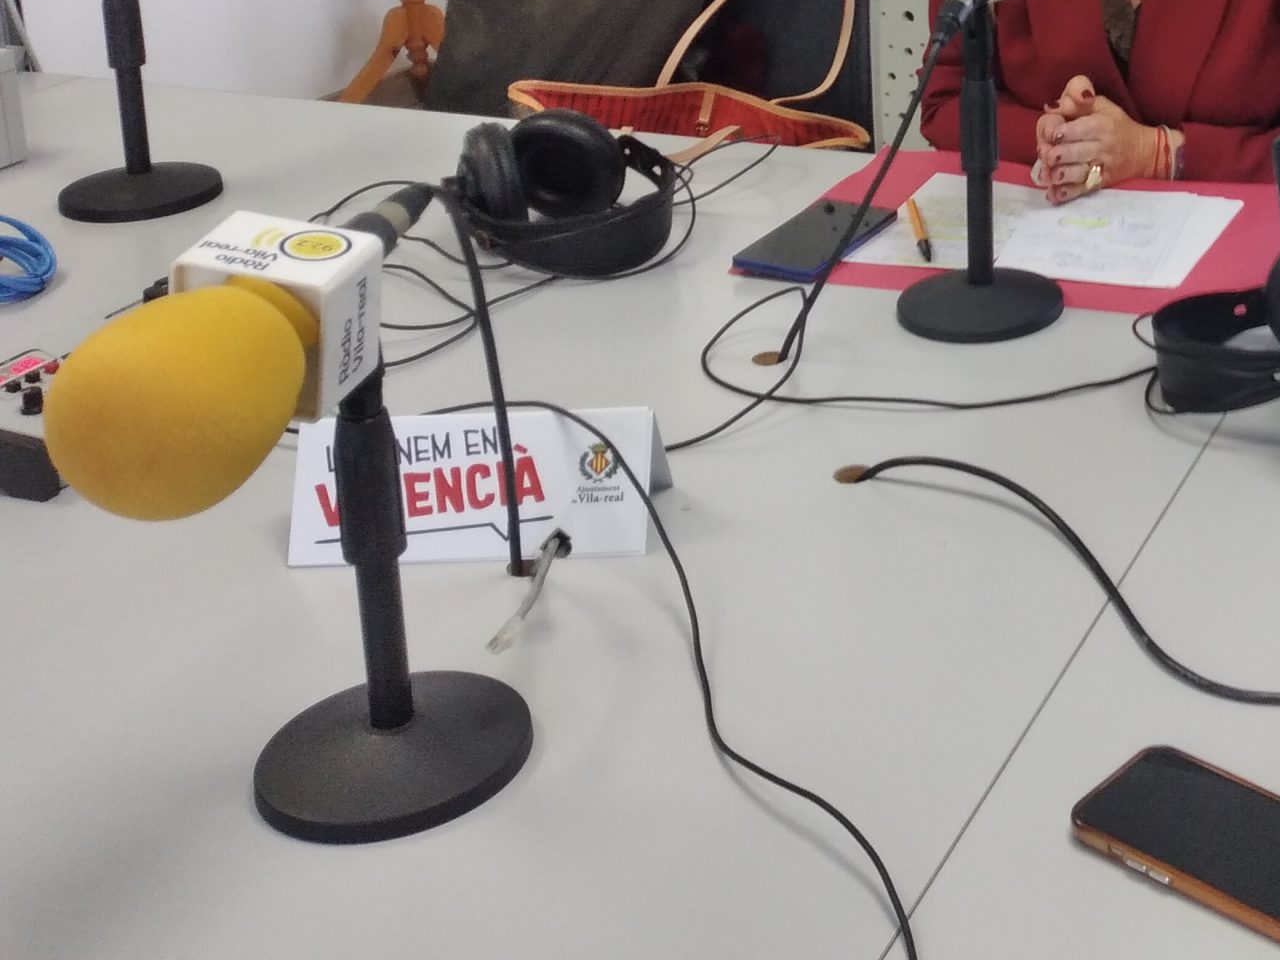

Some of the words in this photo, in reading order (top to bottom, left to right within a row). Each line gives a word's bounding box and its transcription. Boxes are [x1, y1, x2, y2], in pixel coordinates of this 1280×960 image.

[199, 240, 278, 262] Vila-real
[463, 426, 498, 456] EN
[315, 443, 545, 527] VENCIÀ
